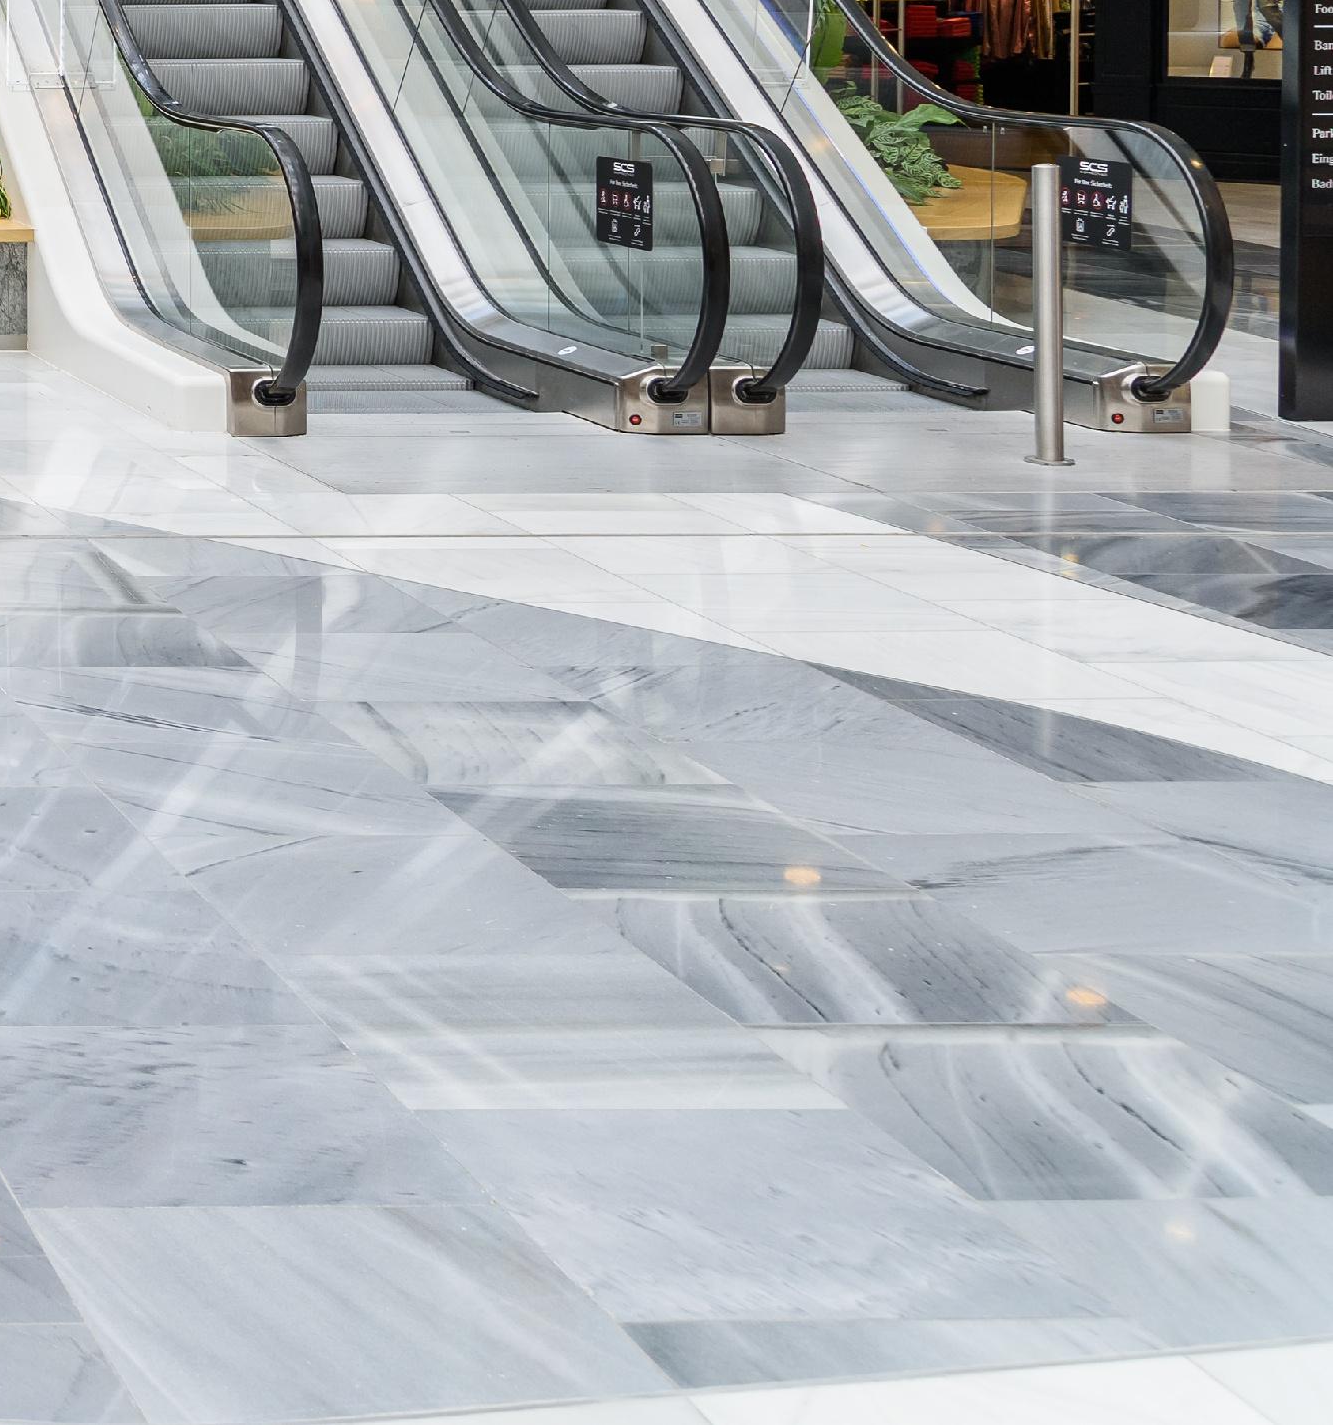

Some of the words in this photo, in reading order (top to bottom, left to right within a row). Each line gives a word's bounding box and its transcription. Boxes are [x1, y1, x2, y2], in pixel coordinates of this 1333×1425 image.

[1313, 65, 1332, 76] Lift
[612, 161, 635, 174] SCS
[1079, 161, 1109, 173] SCS
